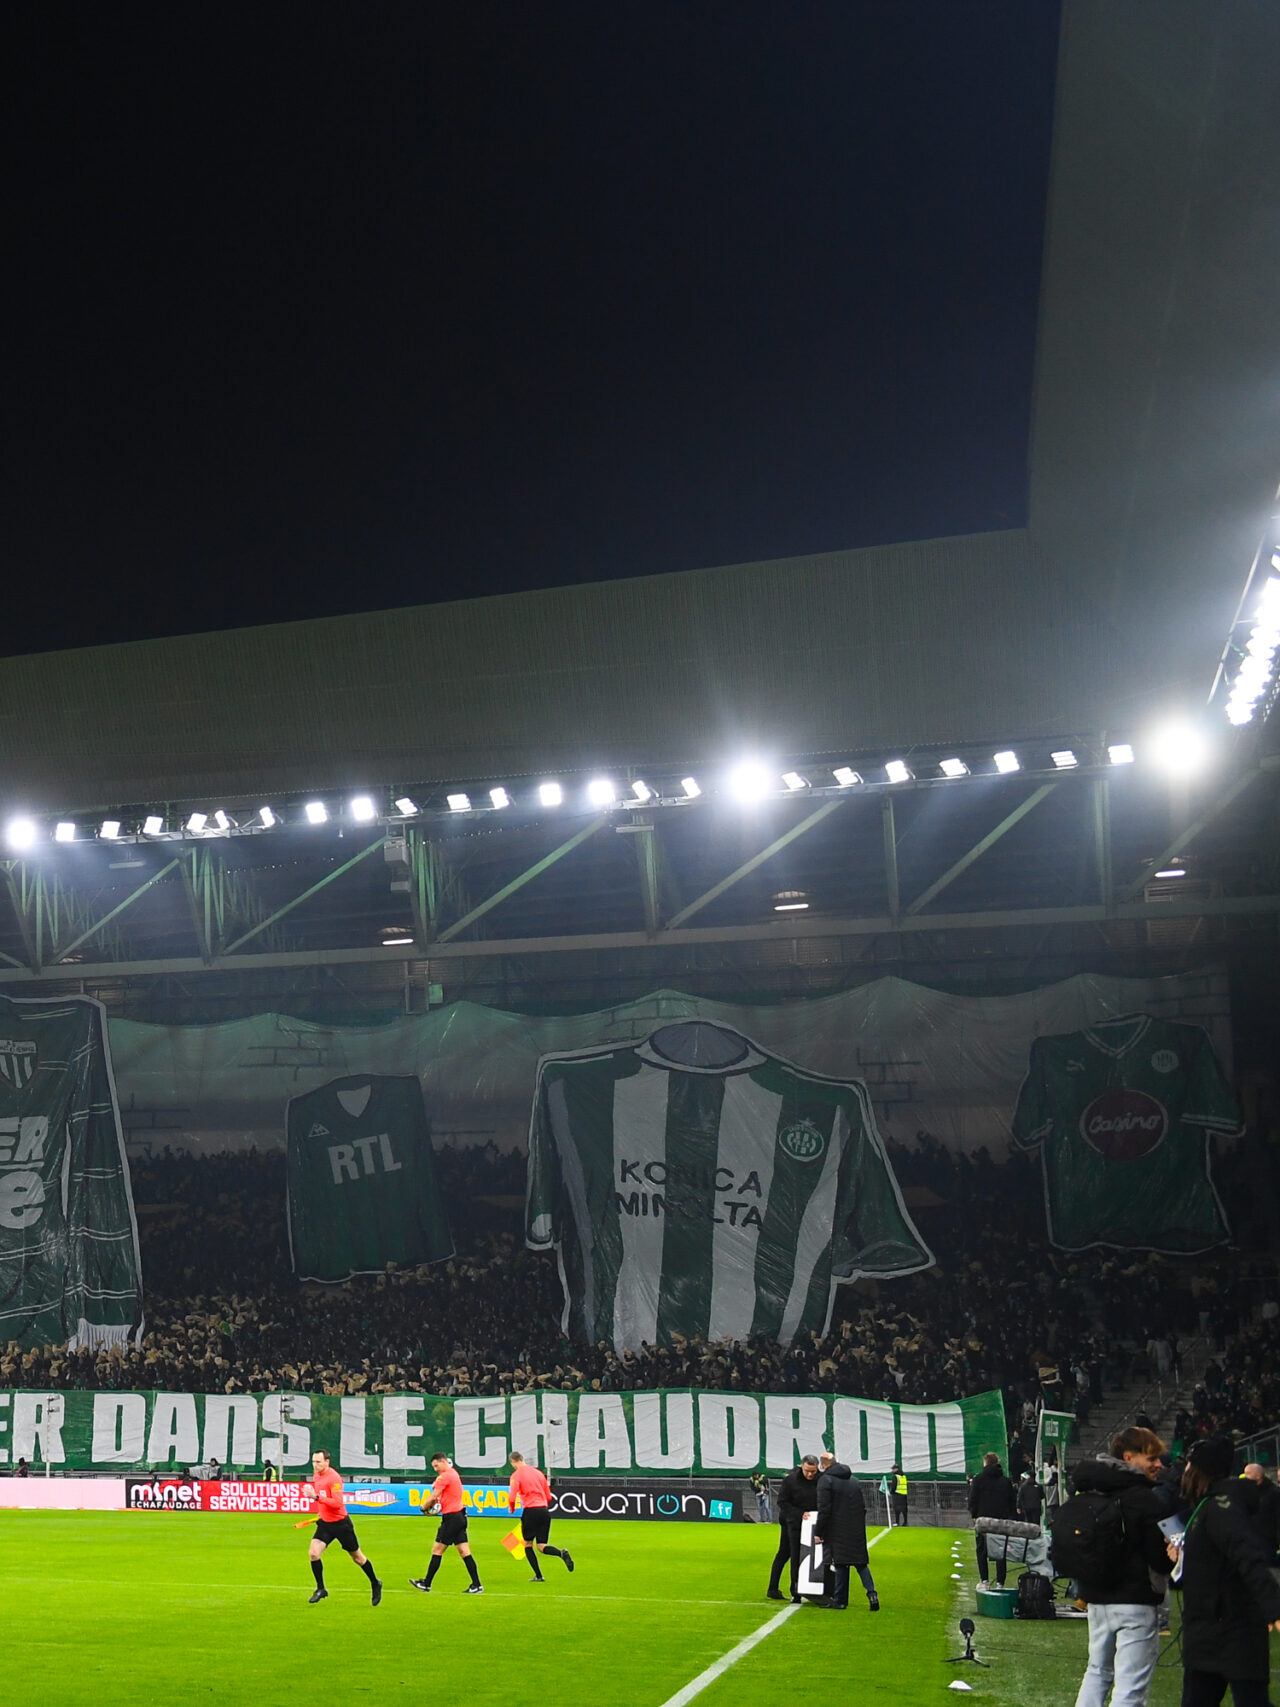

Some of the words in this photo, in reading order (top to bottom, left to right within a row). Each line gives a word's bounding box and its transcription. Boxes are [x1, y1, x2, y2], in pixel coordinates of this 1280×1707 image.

[1088, 1112, 1162, 1134] Casino
[328, 1133, 402, 1184] RTL
[91, 1393, 311, 1467] DANS
[339, 1396, 426, 1470] LE
[453, 1393, 967, 1473] CHAUDRON
[221, 1483, 299, 1497] SOLUTIONS
[131, 1501, 202, 1510] ECHAFAUDAGE
[210, 1496, 277, 1511] SERVICES
